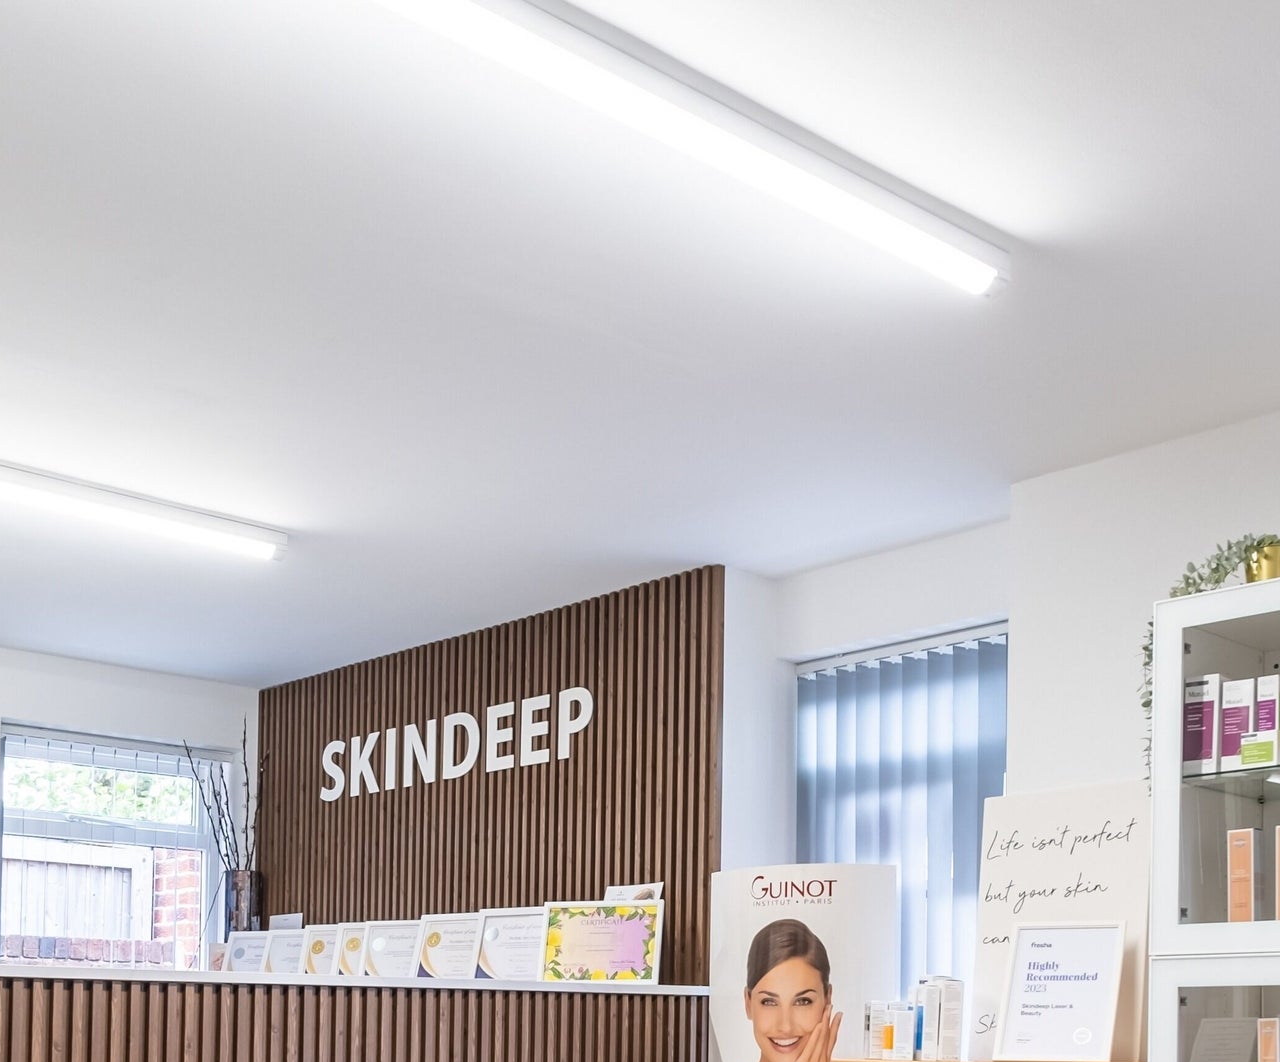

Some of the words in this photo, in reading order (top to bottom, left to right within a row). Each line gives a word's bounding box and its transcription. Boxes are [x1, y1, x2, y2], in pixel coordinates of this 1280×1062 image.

[320, 686, 594, 802] SKINDEEP
[986, 830, 1024, 860] Life
[1032, 826, 1071, 850] isn't
[1070, 817, 1137, 854] perfect
[751, 875, 838, 900] GUINOT
[984, 880, 1014, 902] but
[1013, 886, 1057, 914] your
[1064, 872, 1108, 898] skin
[983, 935, 1010, 944] can
[1027, 961, 1059, 971] Highly
[1026, 973, 1098, 982] Recommended
[1024, 984, 1047, 993] 2023
